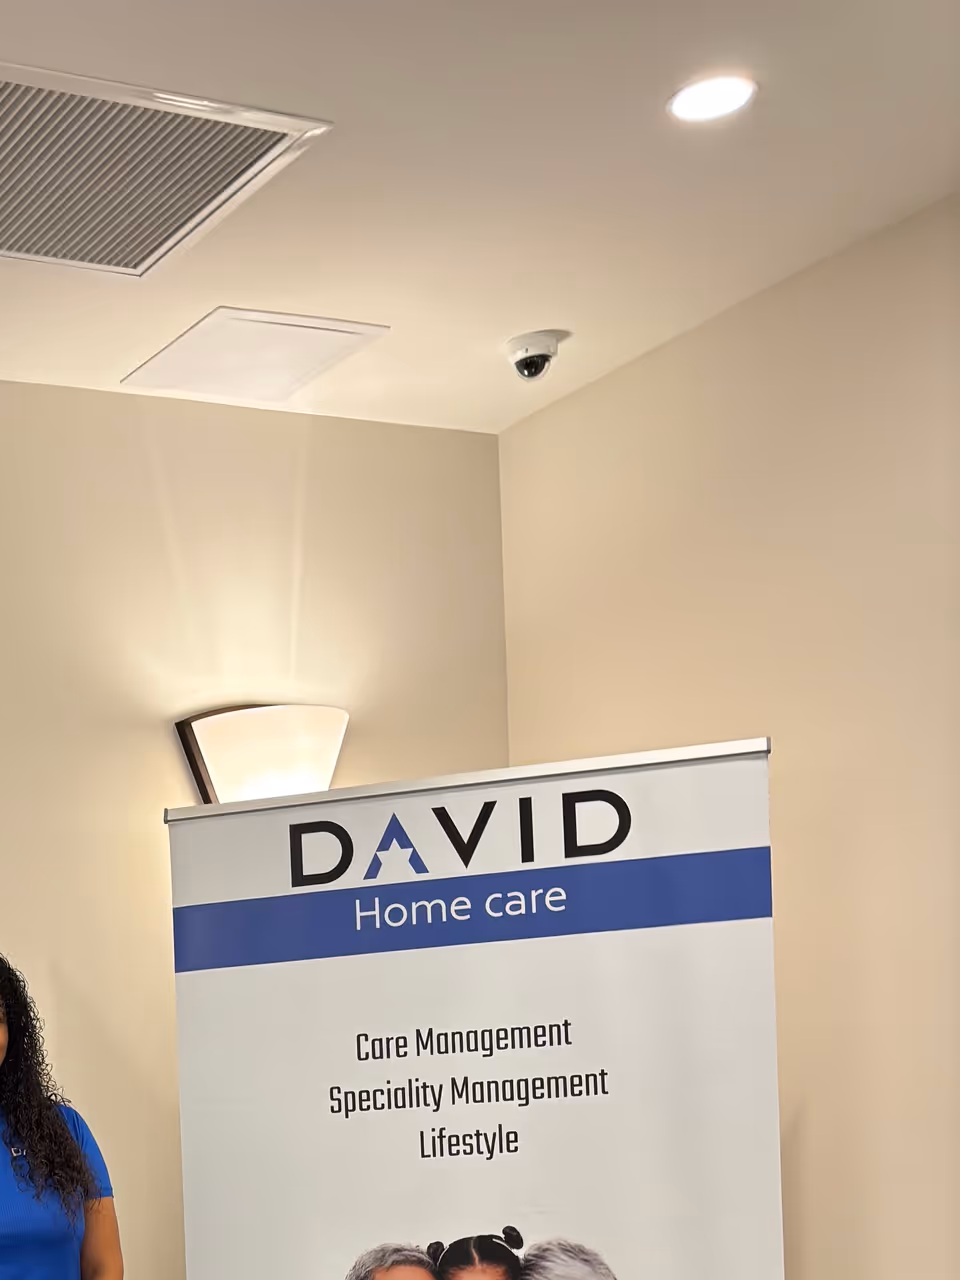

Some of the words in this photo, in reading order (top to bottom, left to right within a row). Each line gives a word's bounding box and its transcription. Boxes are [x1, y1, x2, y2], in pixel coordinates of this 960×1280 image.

[289, 789, 632, 888] DAVID
[354, 897, 472, 931] Home
[484, 886, 567, 919] care
[355, 1031, 409, 1062] Care
[415, 1018, 573, 1058] Management
[328, 1077, 444, 1118] Speciality
[450, 1068, 609, 1107] Management
[419, 1124, 520, 1161] Lifestyle
